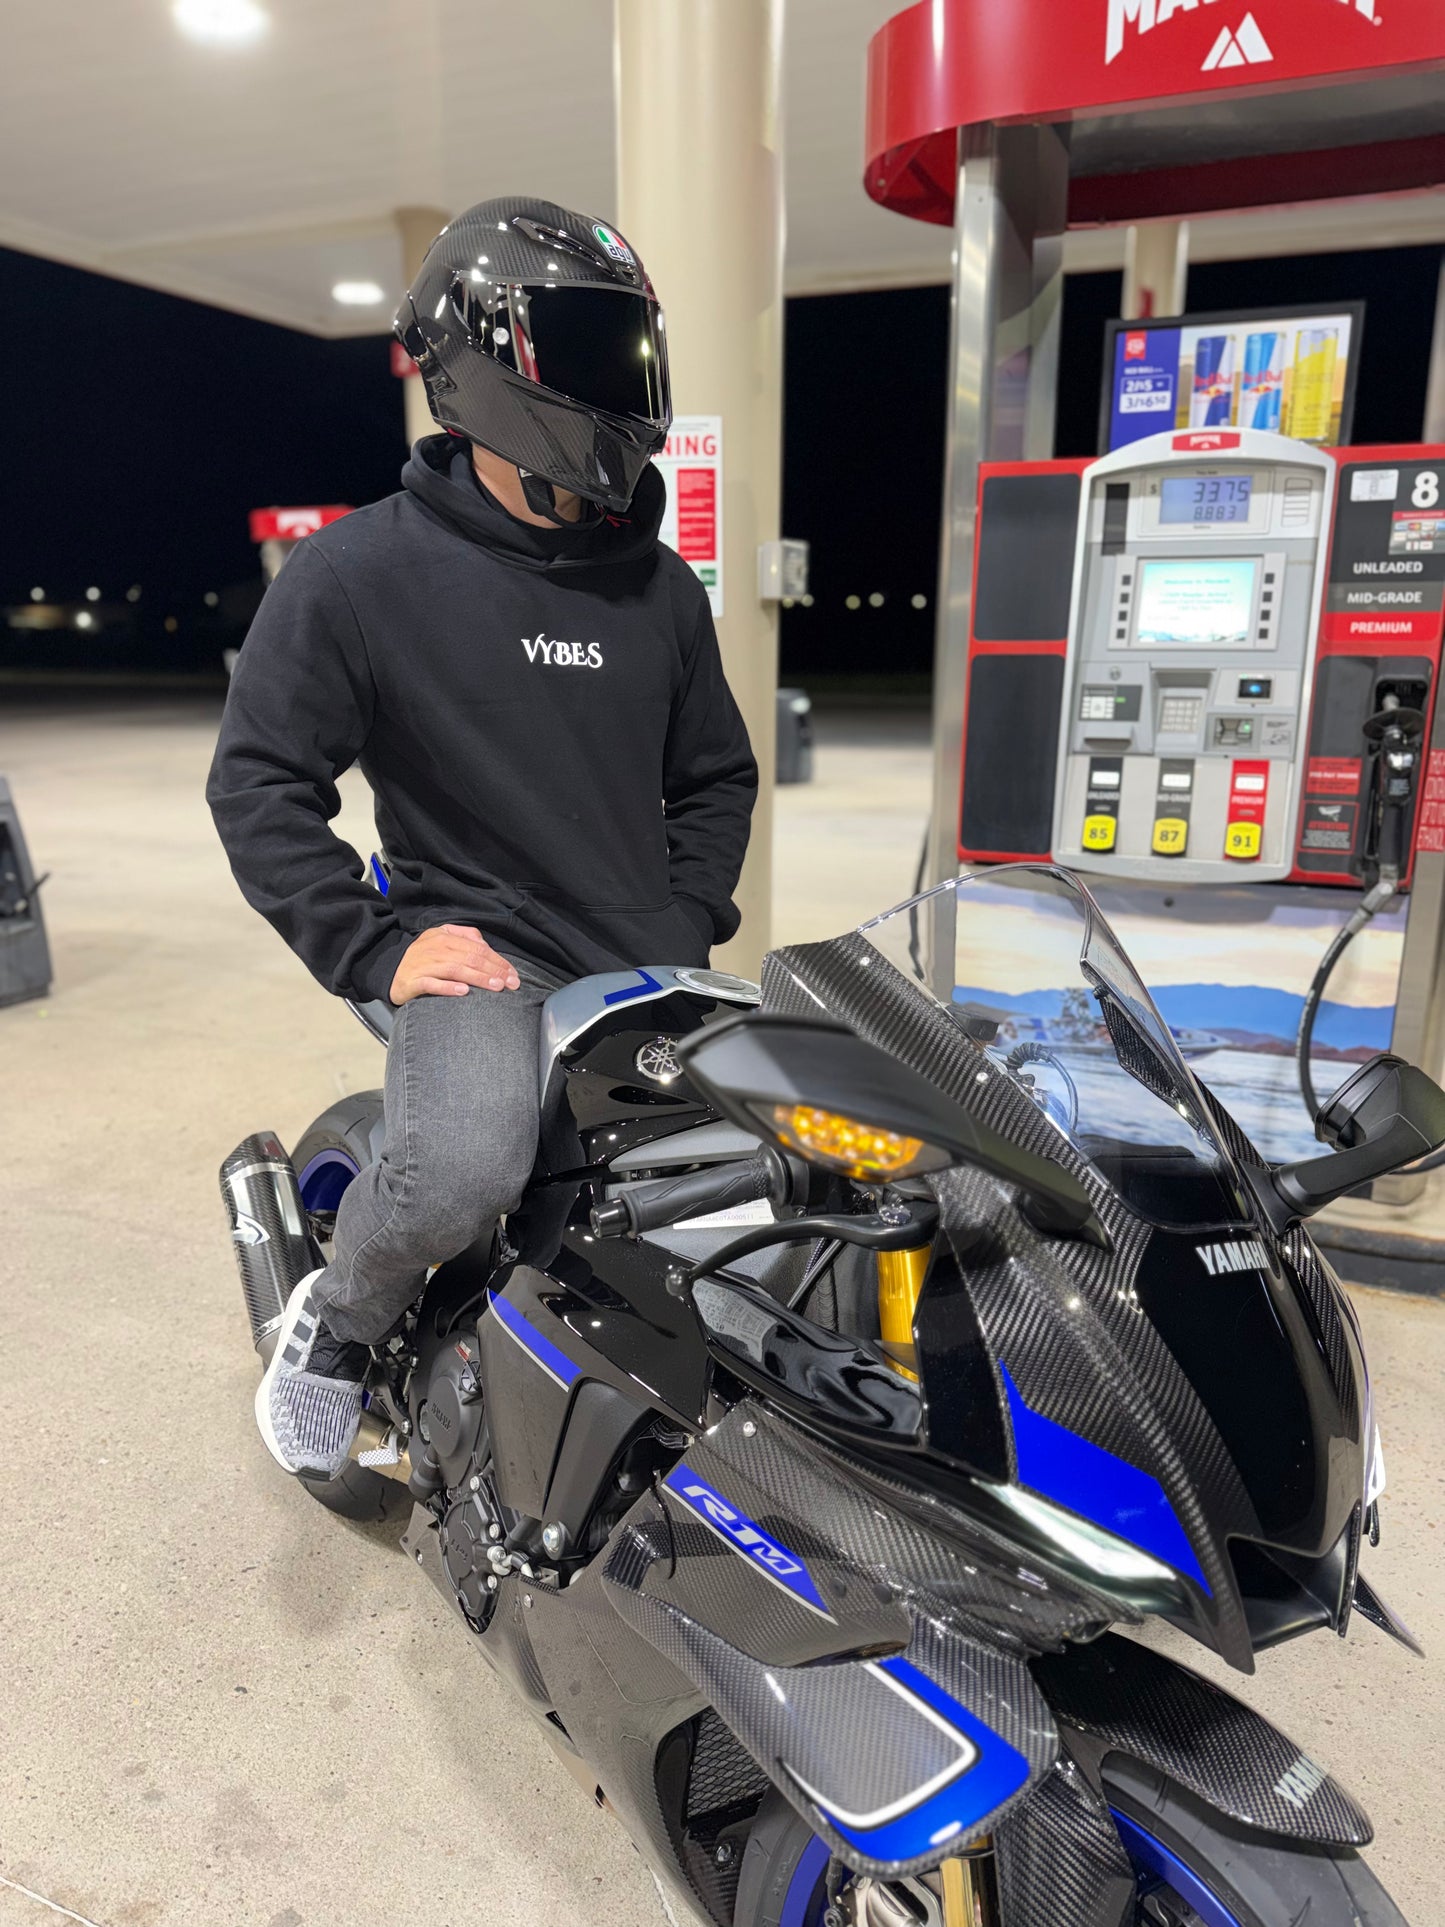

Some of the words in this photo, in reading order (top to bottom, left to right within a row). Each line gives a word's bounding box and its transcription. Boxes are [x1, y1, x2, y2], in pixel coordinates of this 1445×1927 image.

[1411, 471, 1439, 508] 8
[1353, 561, 1423, 574] UNLEADED
[1347, 591, 1422, 604] MID-GRADE
[1350, 621, 1413, 634] PREMIUM
[520, 633, 603, 668] VYBES
[1089, 828, 1108, 839] 85
[1160, 831, 1179, 842] 87
[1233, 836, 1251, 847] 91
[682, 1485, 803, 1575] R1M
